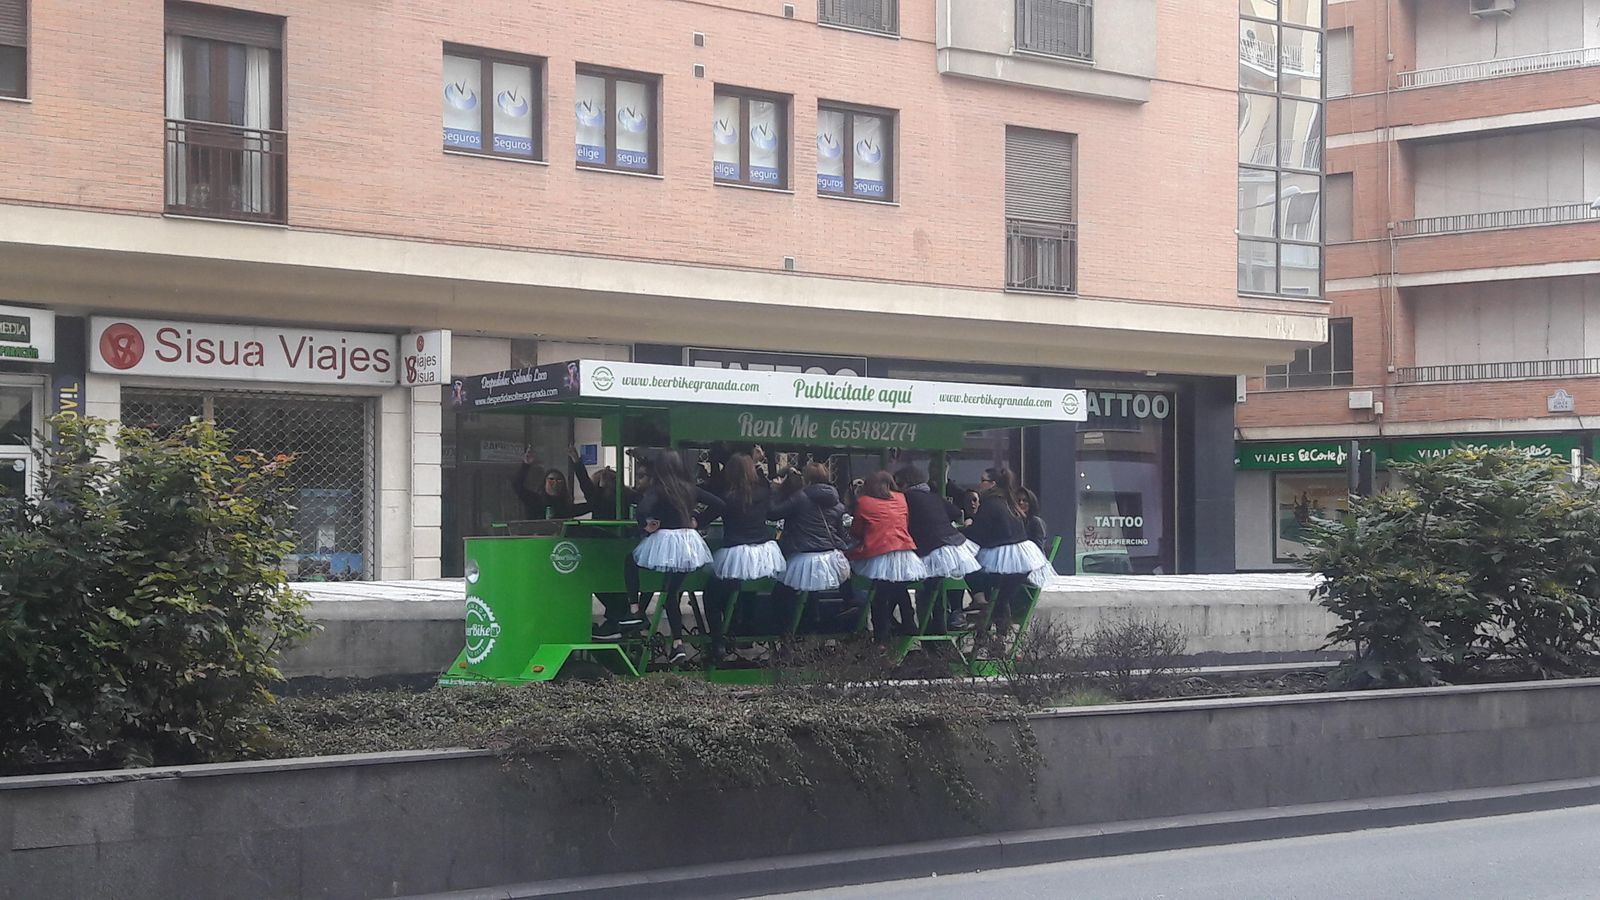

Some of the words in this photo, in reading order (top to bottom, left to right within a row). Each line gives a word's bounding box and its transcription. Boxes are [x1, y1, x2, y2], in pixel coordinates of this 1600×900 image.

[494, 137, 532, 150] Seguros
[577, 147, 600, 160] elige
[617, 153, 647, 165] seguro
[750, 169, 778, 180] seguro
[817, 178, 843, 188] eguros
[854, 180, 884, 192] Seguros
[155, 327, 264, 367] Sisua
[279, 335, 391, 379] Viajes
[622, 375, 760, 393] www.beerbikegranada.com
[878, 385, 914, 408] aquí
[939, 393, 1053, 409] www.beerbikegranada.com
[1086, 391, 1170, 419] ATTOO
[737, 411, 782, 437] Rent
[790, 413, 819, 438] Me
[830, 419, 917, 442] 655482774
[1255, 453, 1295, 464] VIAJES
[1094, 516, 1143, 528] TATTOO
